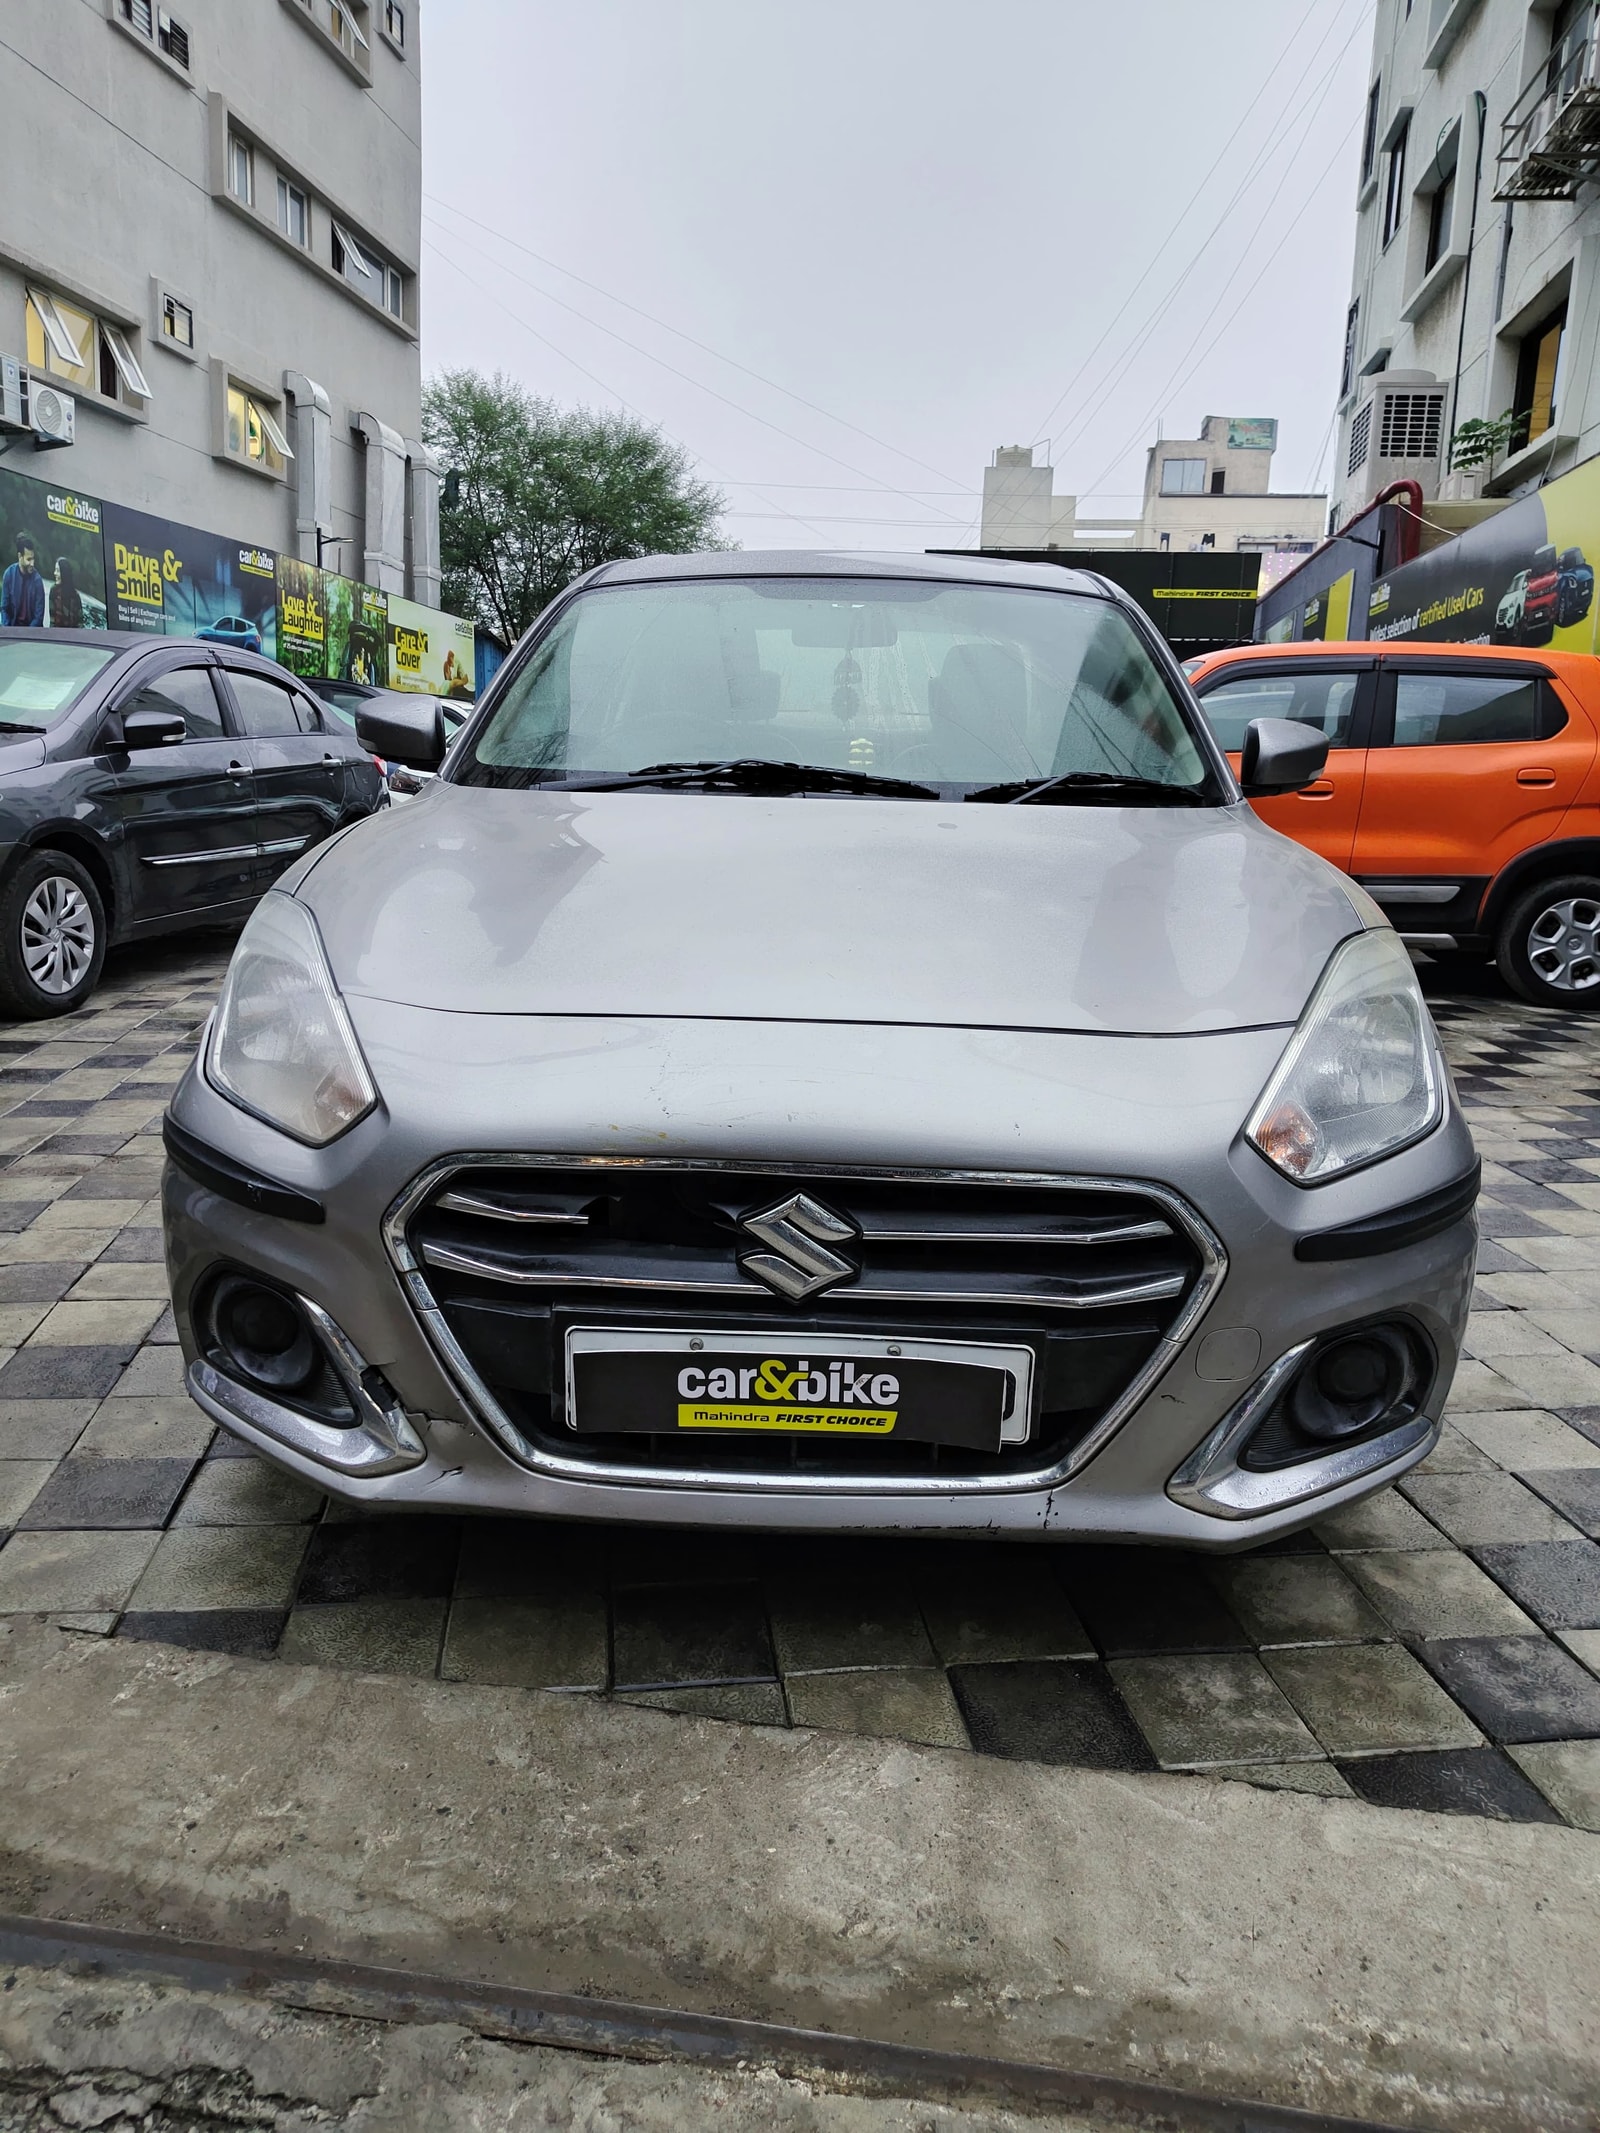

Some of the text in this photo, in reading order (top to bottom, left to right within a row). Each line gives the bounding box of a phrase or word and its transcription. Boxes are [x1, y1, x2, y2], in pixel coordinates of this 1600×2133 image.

[46, 494, 99, 523] car&bike
[114, 543, 183, 583] Drive &
[239, 549, 274, 571] car&bike
[117, 569, 162, 601] Smile
[281, 589, 319, 616] Love &
[1387, 614, 1412, 639] selection
[1411, 608, 1421, 631] of
[1419, 596, 1448, 628] certified
[1447, 588, 1467, 617] Used
[1466, 587, 1484, 610] Cars
[283, 607, 323, 634] Laughter
[395, 626, 429, 653] Care &
[396, 646, 421, 669] Cover
[677, 1359, 900, 1406] car&bike
[693, 1411, 888, 1427] Mahindra FIRST CHOICE
